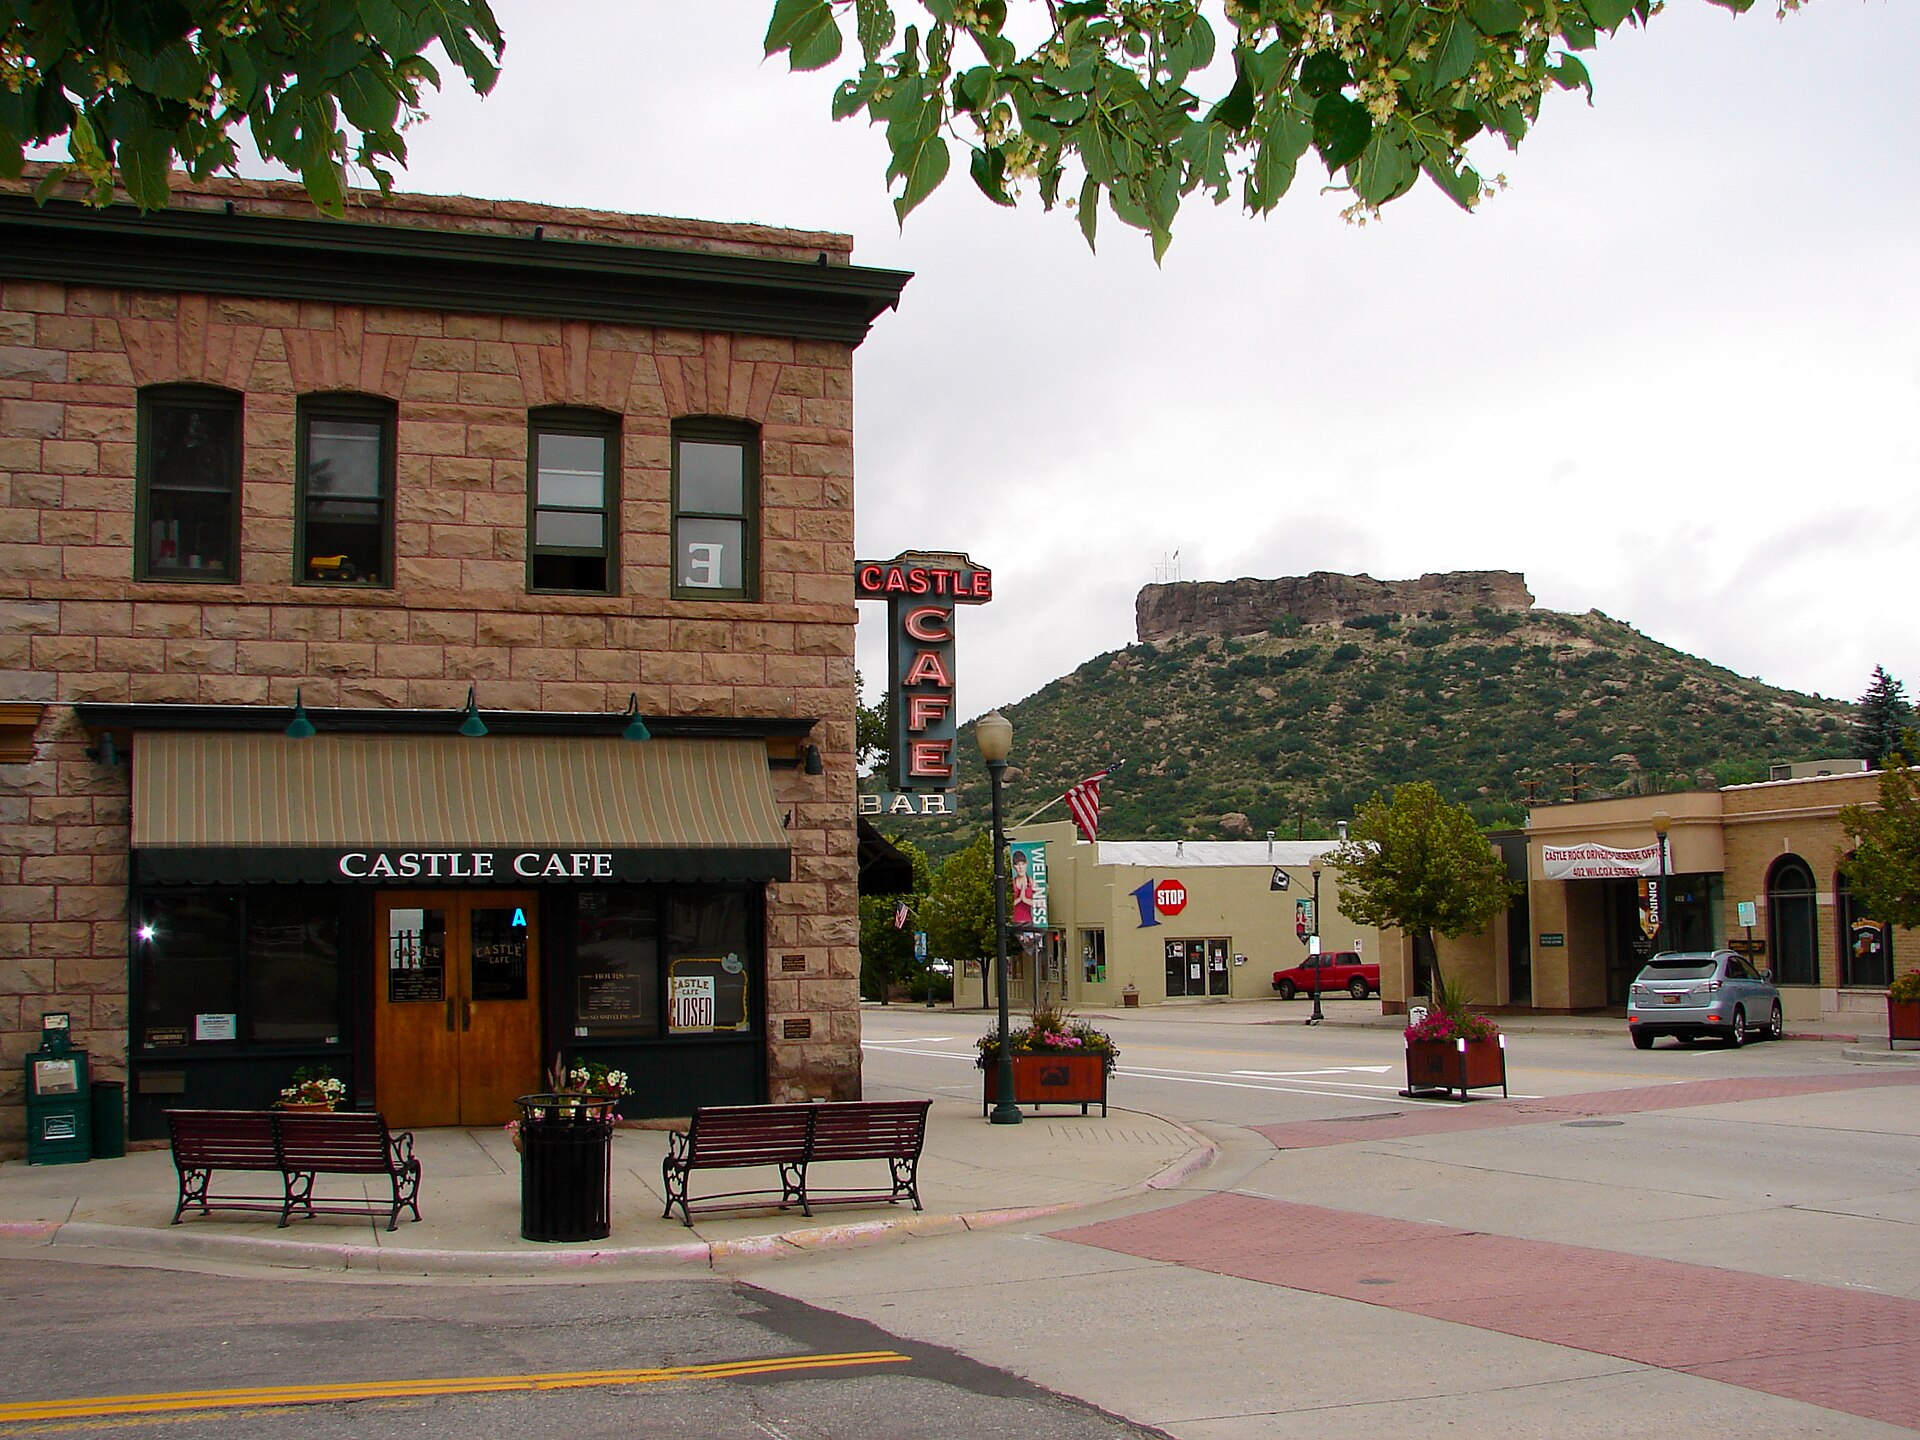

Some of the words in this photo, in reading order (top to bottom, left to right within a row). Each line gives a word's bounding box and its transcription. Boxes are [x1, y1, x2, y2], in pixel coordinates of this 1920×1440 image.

[859, 565, 992, 597] CASTLE
[902, 605, 955, 777] CAFE
[858, 794, 953, 815] BAR
[338, 853, 495, 877] CASTLE
[513, 853, 613, 877] CAFE
[1545, 850, 1567, 861] CASTLE
[1568, 850, 1585, 861] ROCK
[1573, 868, 1585, 877] 402
[1586, 867, 1613, 877] WILCOX
[1614, 867, 1640, 877] STREET
[1031, 847, 1048, 925] WELLNESS
[1128, 878, 1162, 929] 1
[1157, 889, 1185, 906] STOP
[1648, 881, 1659, 923] DINING
[512, 908, 527, 927] A
[476, 943, 522, 958] CASTLE
[489, 956, 510, 964] CAFE
[594, 972, 625, 980] HOURS
